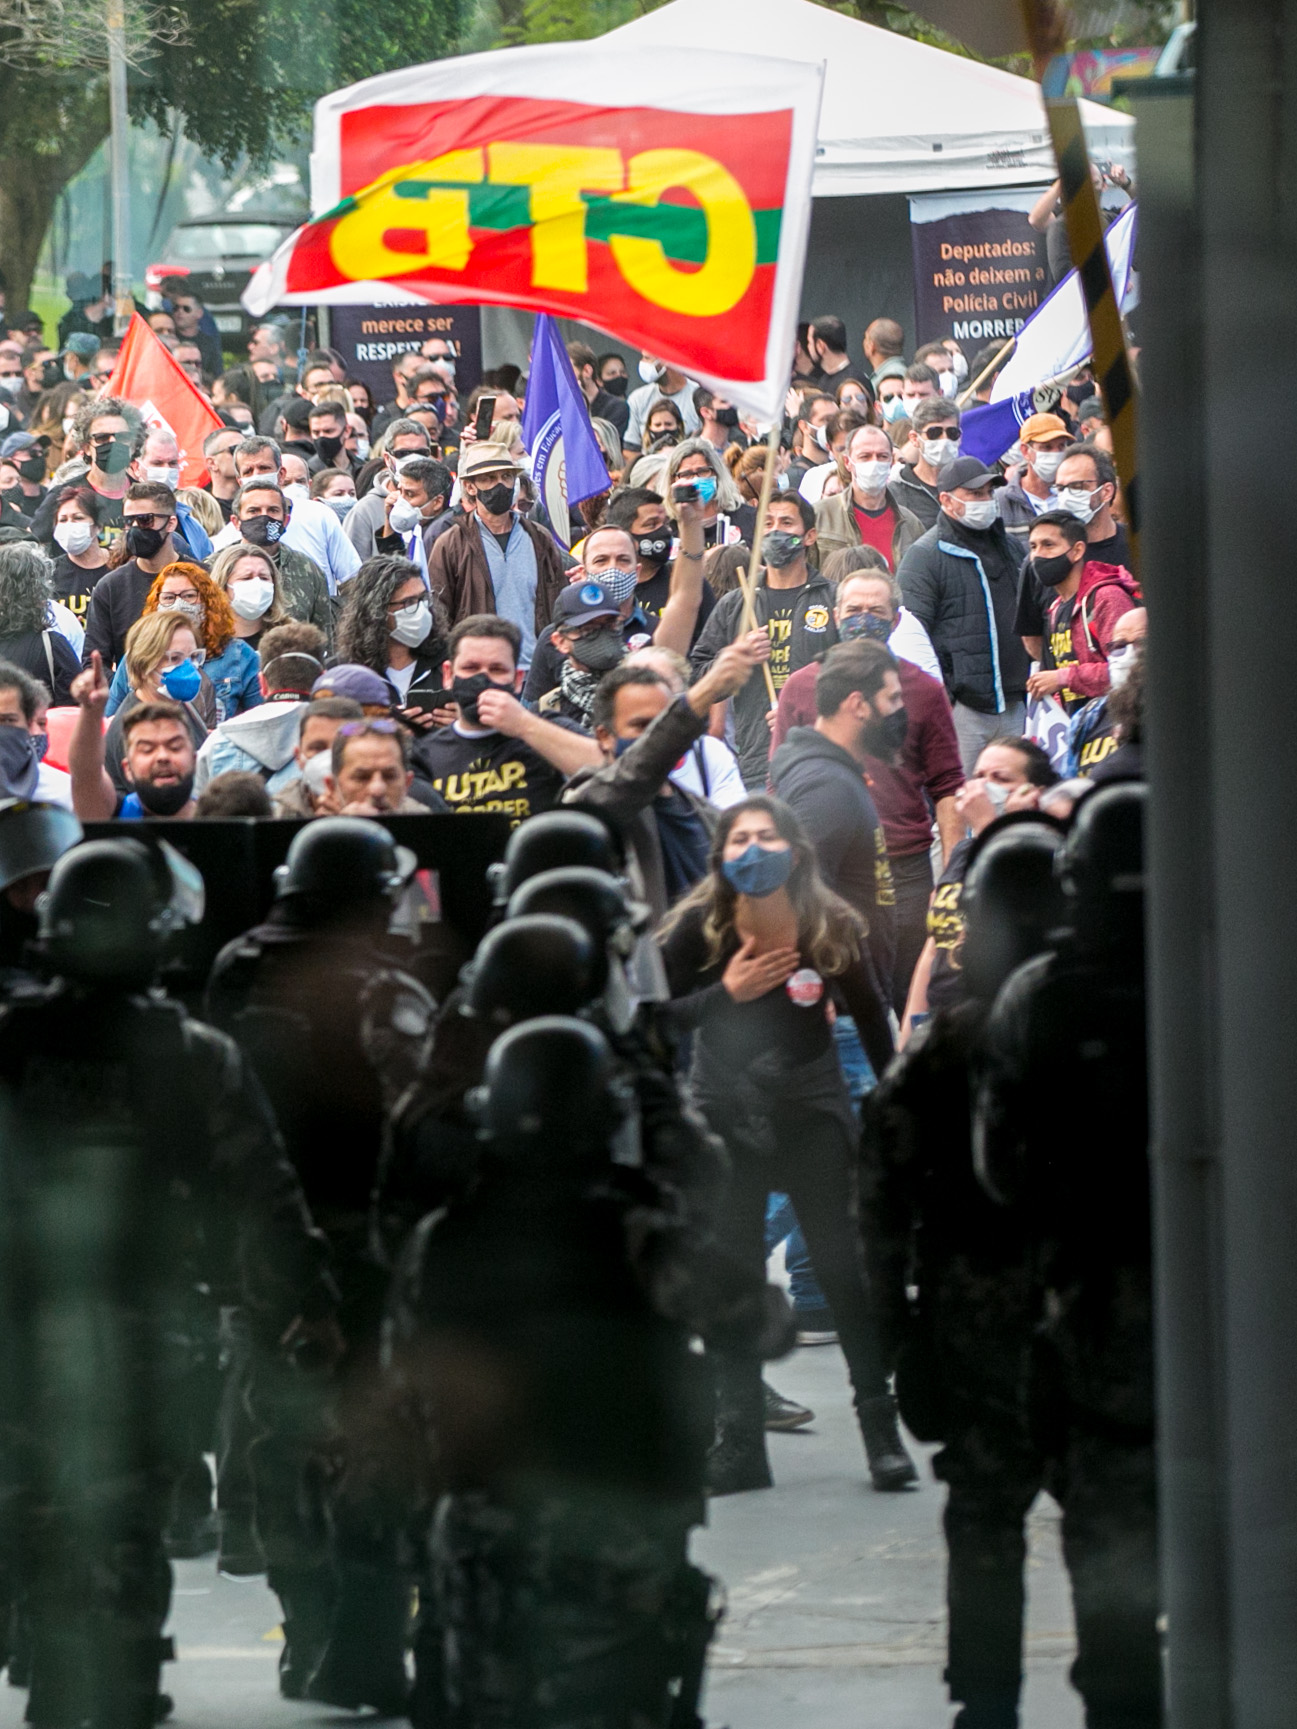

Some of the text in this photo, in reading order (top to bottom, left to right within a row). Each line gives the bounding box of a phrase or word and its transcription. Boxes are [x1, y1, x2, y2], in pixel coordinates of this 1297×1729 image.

[940, 239, 1036, 264] Deputados:
[933, 266, 1045, 288] não deixem a
[943, 290, 1038, 314] Polícia Civil
[361, 317, 454, 334] merece ser
